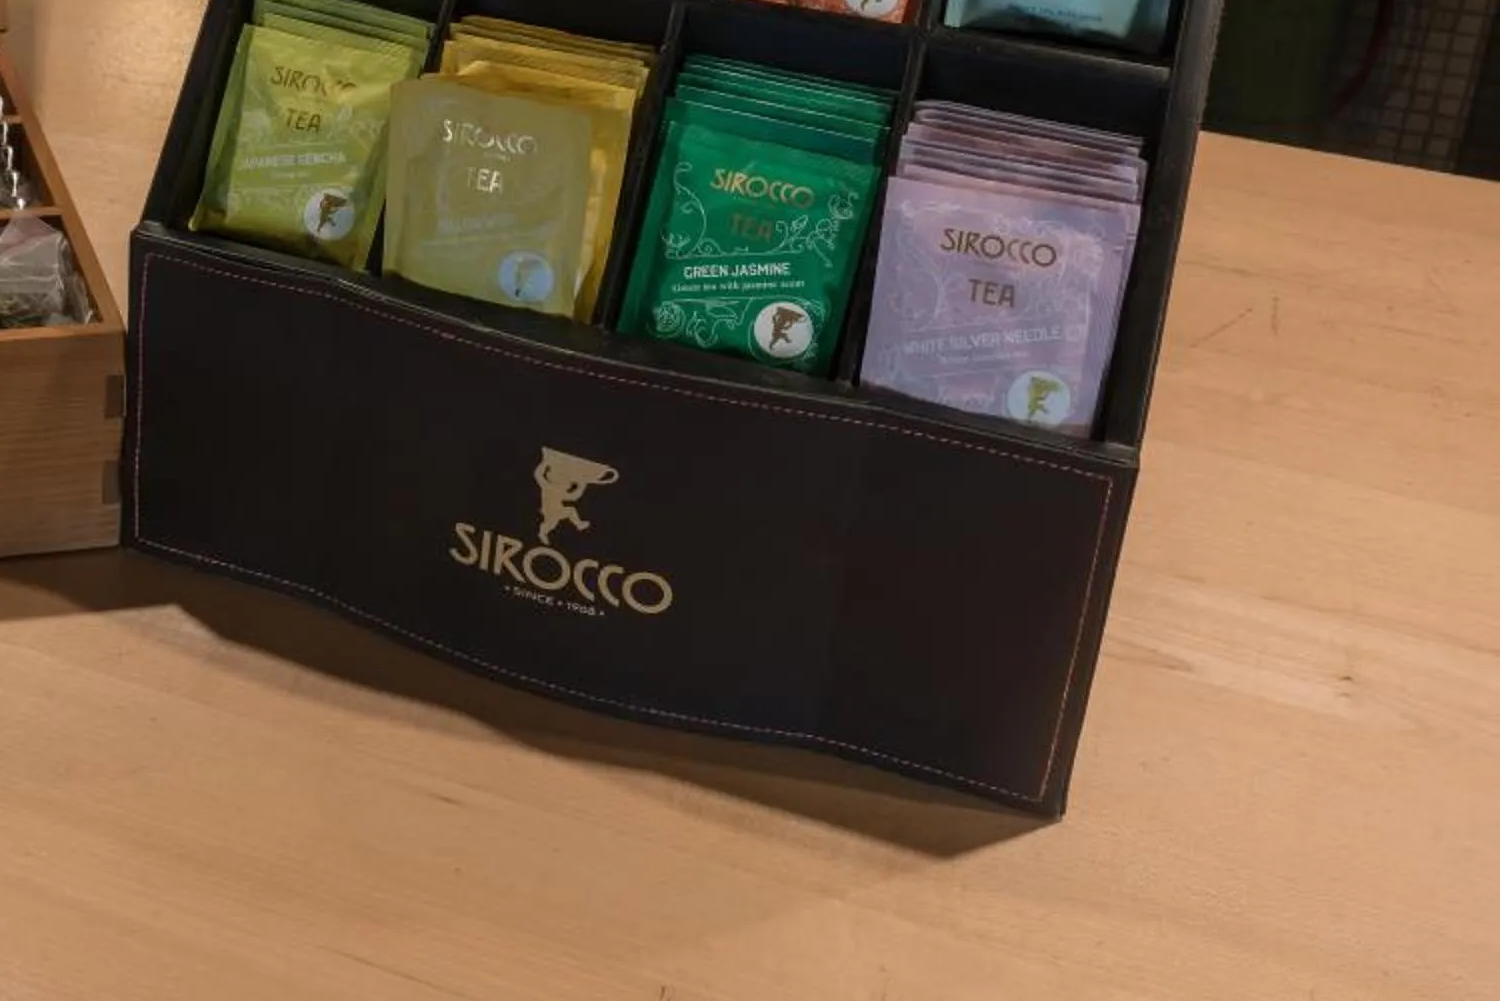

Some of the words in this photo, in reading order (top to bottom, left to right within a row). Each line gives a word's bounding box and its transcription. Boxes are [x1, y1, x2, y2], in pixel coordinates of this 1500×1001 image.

[286, 107, 322, 134] TEA
[442, 119, 538, 155] SIROCCO
[467, 166, 503, 194] TEA
[709, 168, 816, 209] SIROCCO
[939, 227, 1058, 268] SIROCCO
[683, 264, 729, 280] GREEN
[731, 262, 792, 279] JASMINE
[967, 278, 1016, 309] TEA
[449, 521, 674, 615] SIROCCO
[512, 585, 554, 606] SINCE
